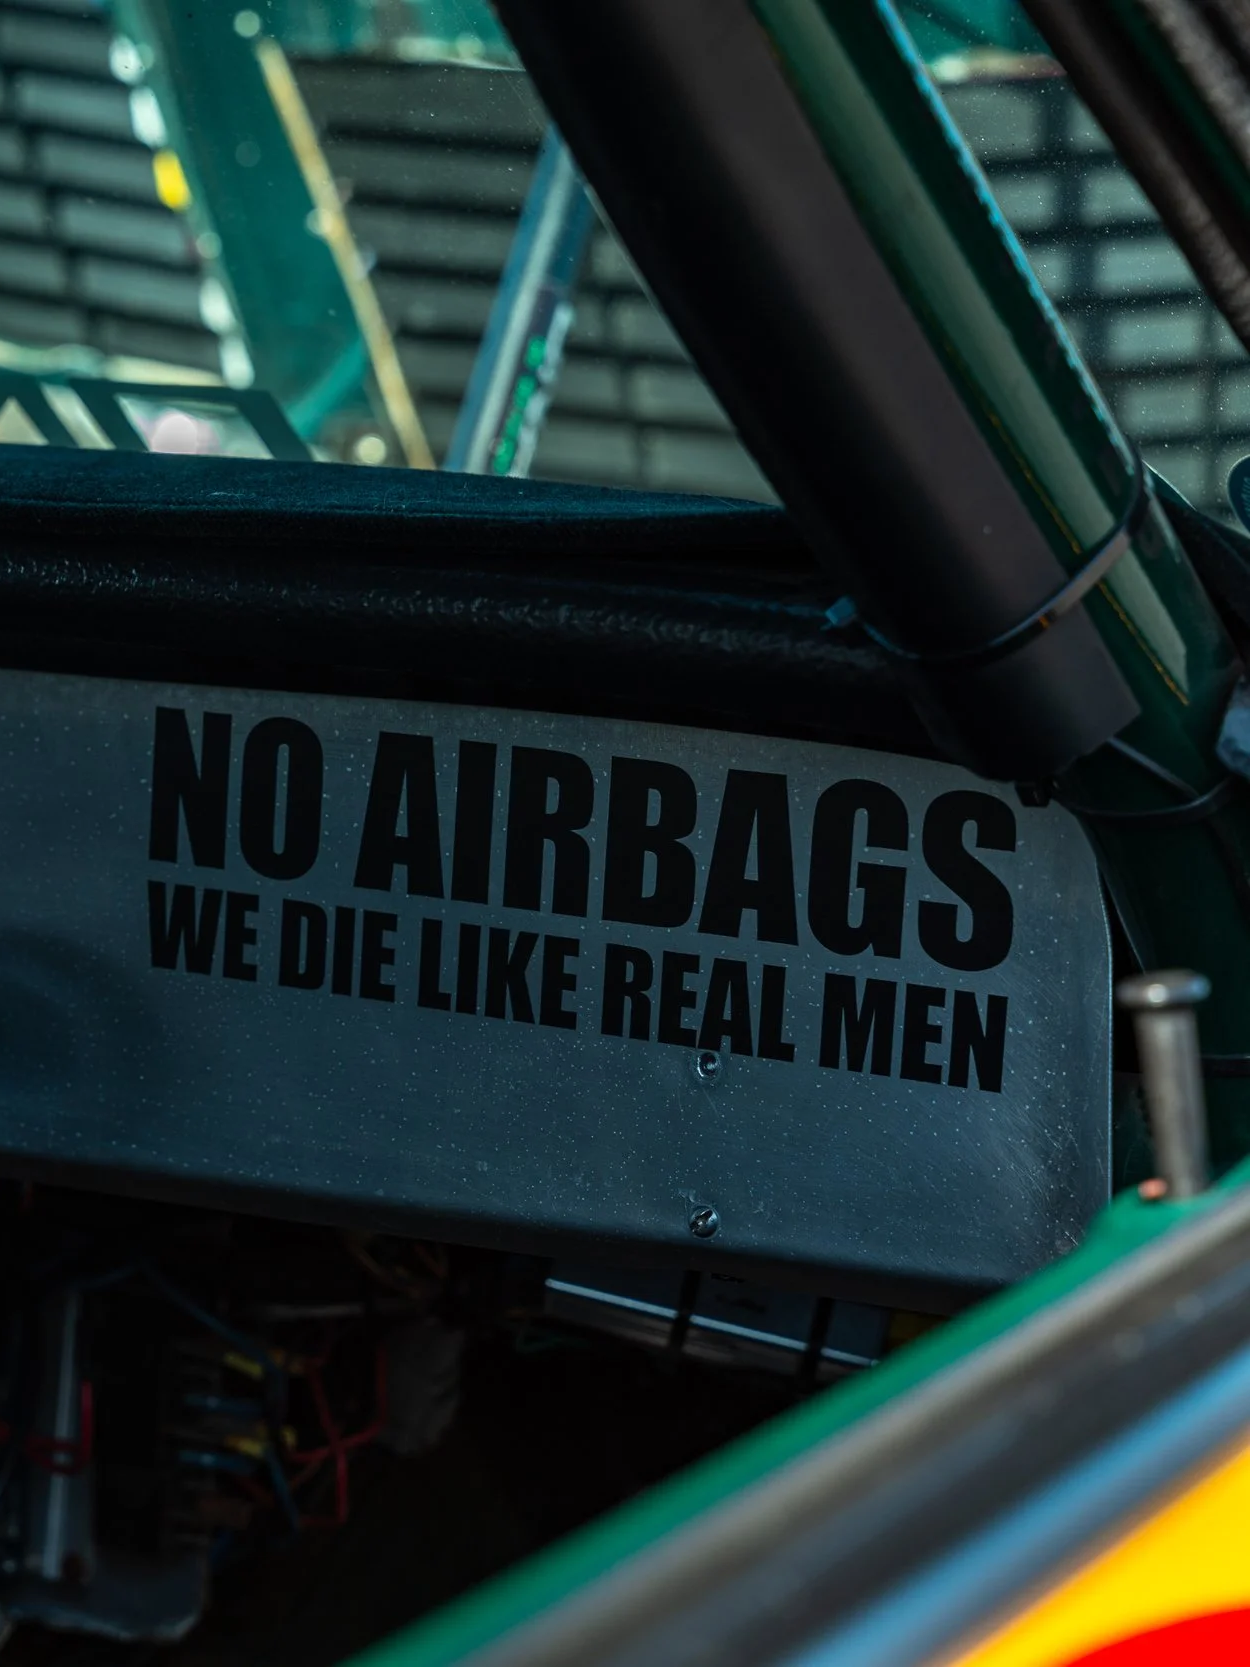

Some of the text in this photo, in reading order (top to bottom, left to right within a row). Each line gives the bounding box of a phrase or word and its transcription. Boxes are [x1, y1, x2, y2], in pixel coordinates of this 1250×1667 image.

[149, 706, 1017, 972] NO AIRBAGS
[148, 880, 1009, 1095] WE DIE LIKE REAL MEN
